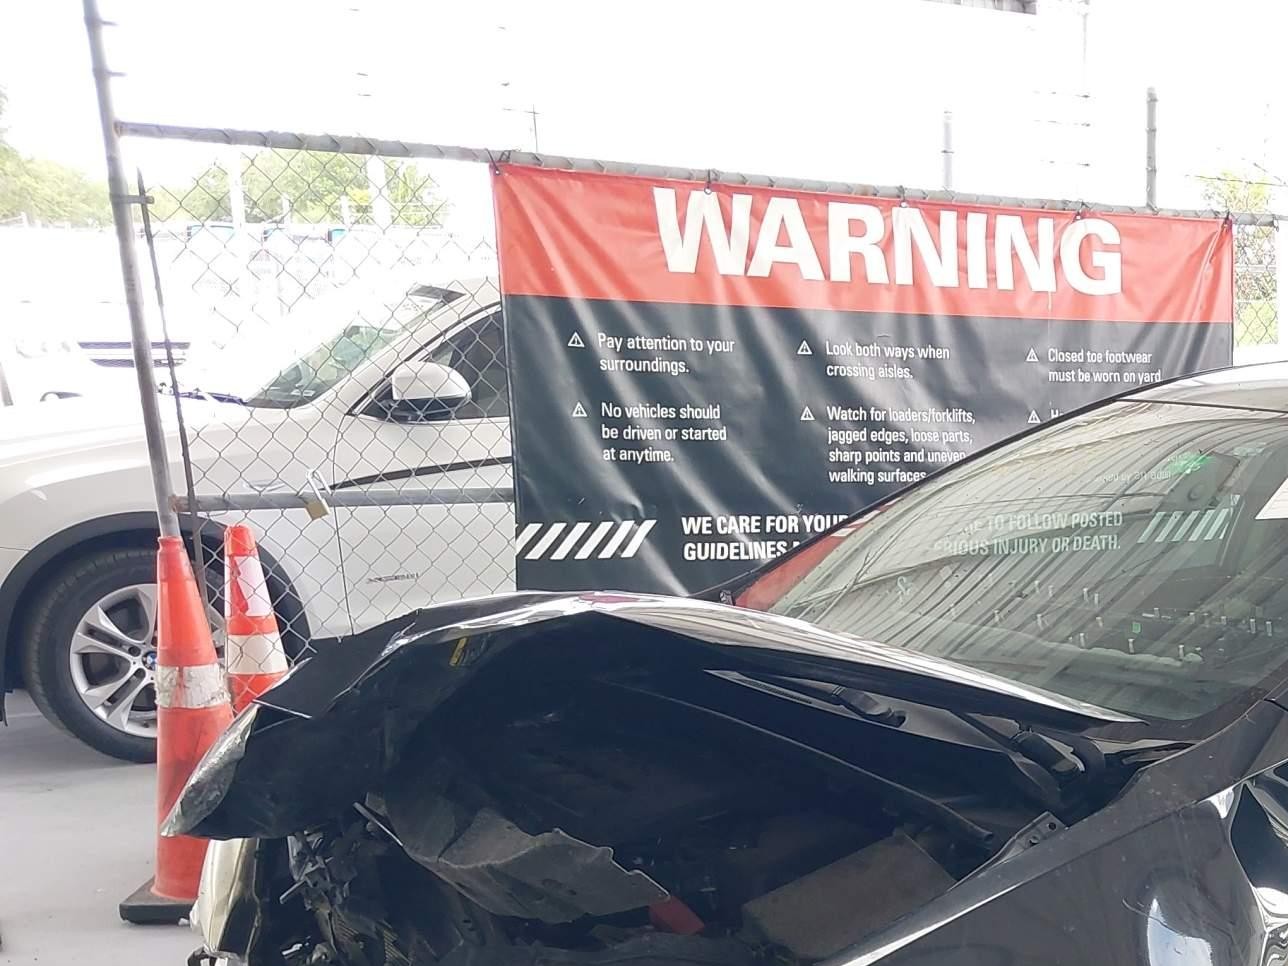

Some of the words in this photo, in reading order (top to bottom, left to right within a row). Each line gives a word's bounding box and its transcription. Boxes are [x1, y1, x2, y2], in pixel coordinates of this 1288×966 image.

[653, 187, 1122, 295] WARNING
[598, 332, 623, 352] Pay
[627, 336, 688, 351] attention
[690, 337, 703, 351] to
[706, 340, 735, 355] your
[826, 341, 852, 356] Look
[855, 342, 881, 357] both
[883, 345, 915, 361] ways
[917, 346, 950, 359] when
[1048, 348, 1084, 362] Closed
[1087, 350, 1103, 363] toe
[1105, 350, 1153, 364] footwear
[600, 357, 690, 374] surroundings.
[826, 363, 875, 380] crossing
[878, 364, 913, 379] aisles.
[1049, 369, 1075, 383] must
[1078, 369, 1091, 383] be
[1093, 372, 1121, 383] worn
[1123, 372, 1136, 383] on
[601, 402, 622, 418] No
[624, 403, 676, 419] vehicles
[679, 404, 721, 419] should
[826, 406, 867, 422] Watch
[869, 407, 887, 421] for
[889, 407, 976, 424] loaders/forklifts,
[602, 425, 618, 439] be
[623, 426, 662, 440] driven
[664, 428, 678, 441] or
[681, 427, 727, 441] started
[828, 428, 867, 444] jagged
[870, 429, 909, 444] edges,
[911, 429, 940, 442] loose
[942, 431, 973, 446] parts,
[603, 449, 617, 461] at
[619, 448, 674, 464] anytime.
[829, 448, 862, 465] sharp
[865, 449, 900, 465] points
[904, 449, 925, 463] and
[927, 451, 966, 463] uneven
[828, 469, 875, 485] walking
[682, 516, 712, 534] WE
[717, 516, 761, 534] CARE
[765, 515, 800, 533] FOR
[988, 513, 1006, 531] TO
[1009, 512, 1068, 531] FOLLOW
[1071, 511, 1123, 529] POSTED
[684, 541, 787, 561] GUIDELINES
[934, 539, 989, 557] ERIOUS
[993, 537, 1048, 555] INJURY
[1052, 537, 1070, 552] OR
[1073, 535, 1121, 551] DEATH.
